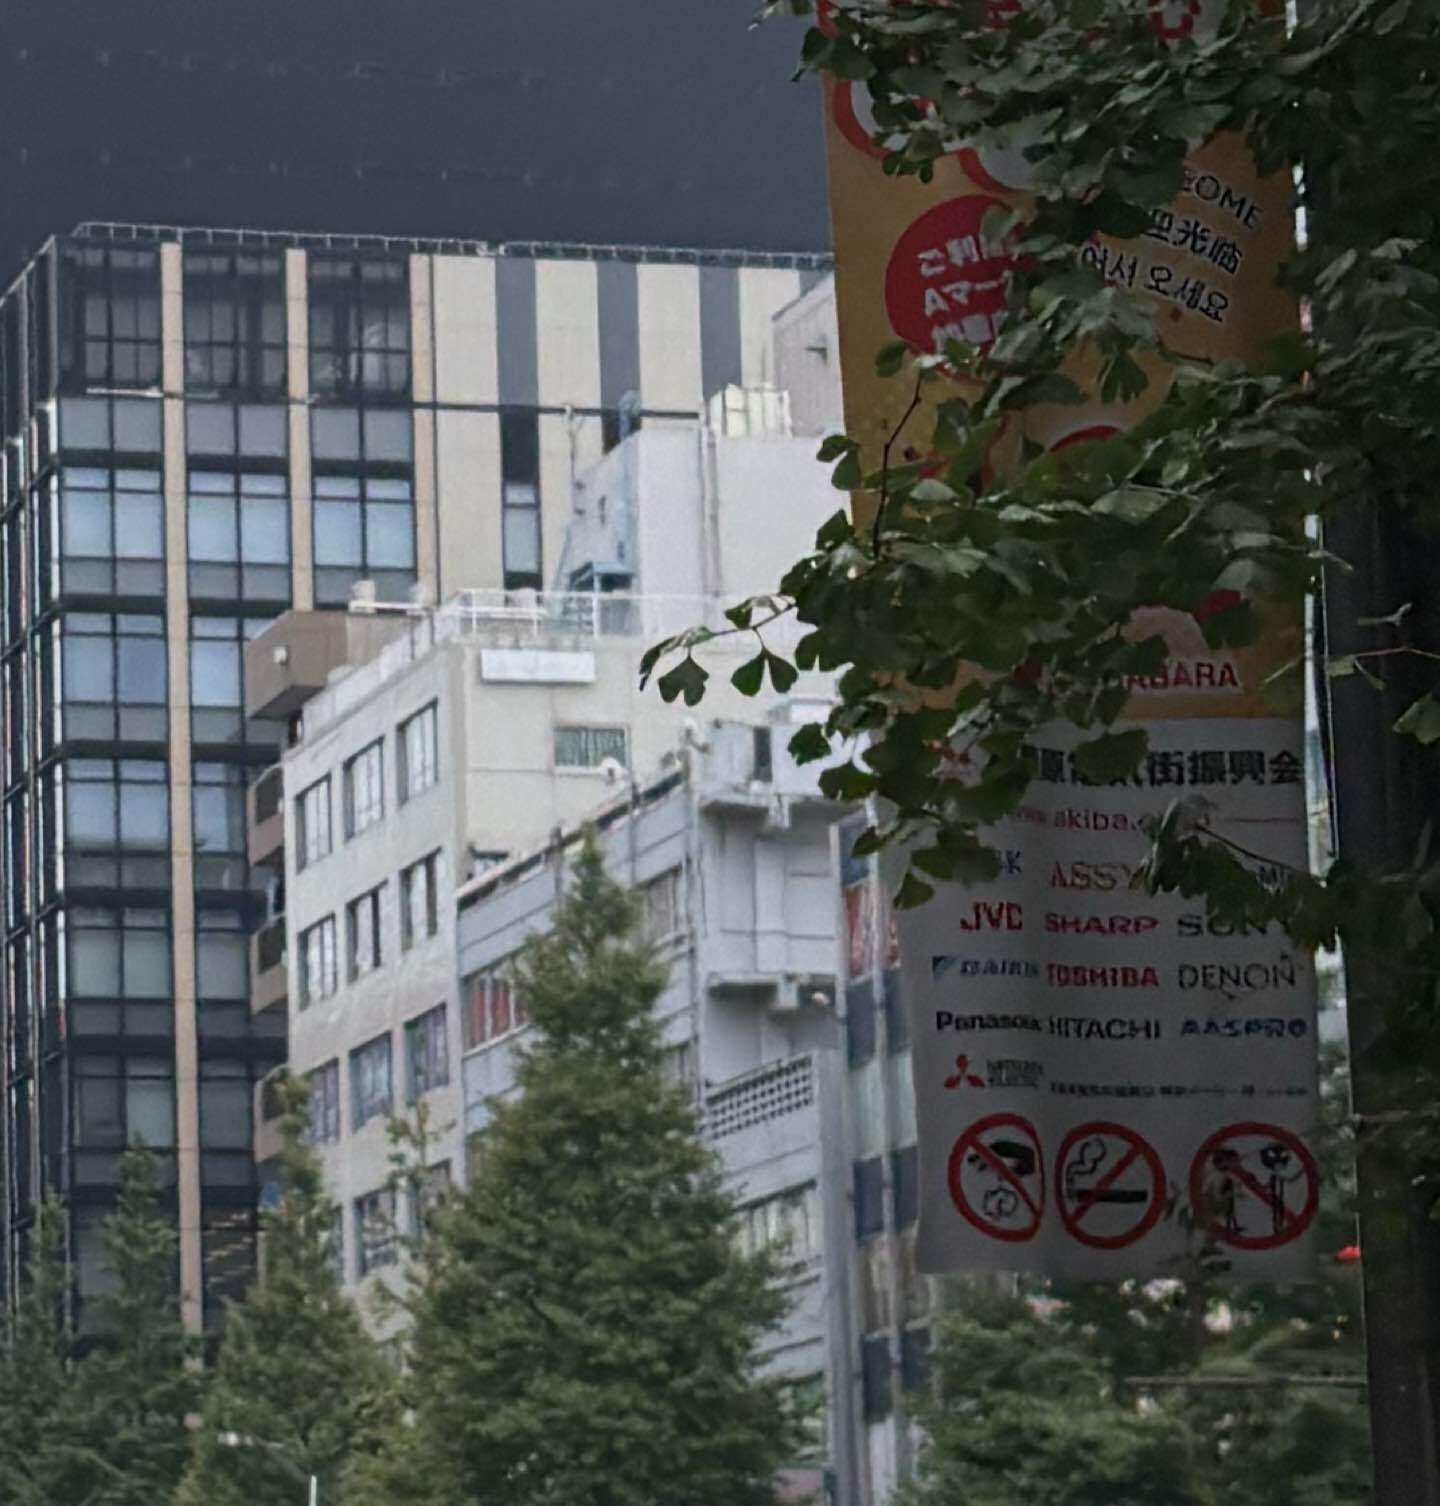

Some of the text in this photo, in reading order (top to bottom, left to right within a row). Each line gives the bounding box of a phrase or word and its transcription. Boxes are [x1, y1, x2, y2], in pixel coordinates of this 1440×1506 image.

[1148, 265, 1231, 323] 오세요
[960, 902, 1023, 931] JVC
[1045, 913, 1159, 935] SHARP
[1177, 914, 1278, 937] SON
[1047, 963, 1160, 988] TOSHIBA
[1178, 963, 1295, 990] DENON
[1049, 1018, 1161, 1040] HITACHI
